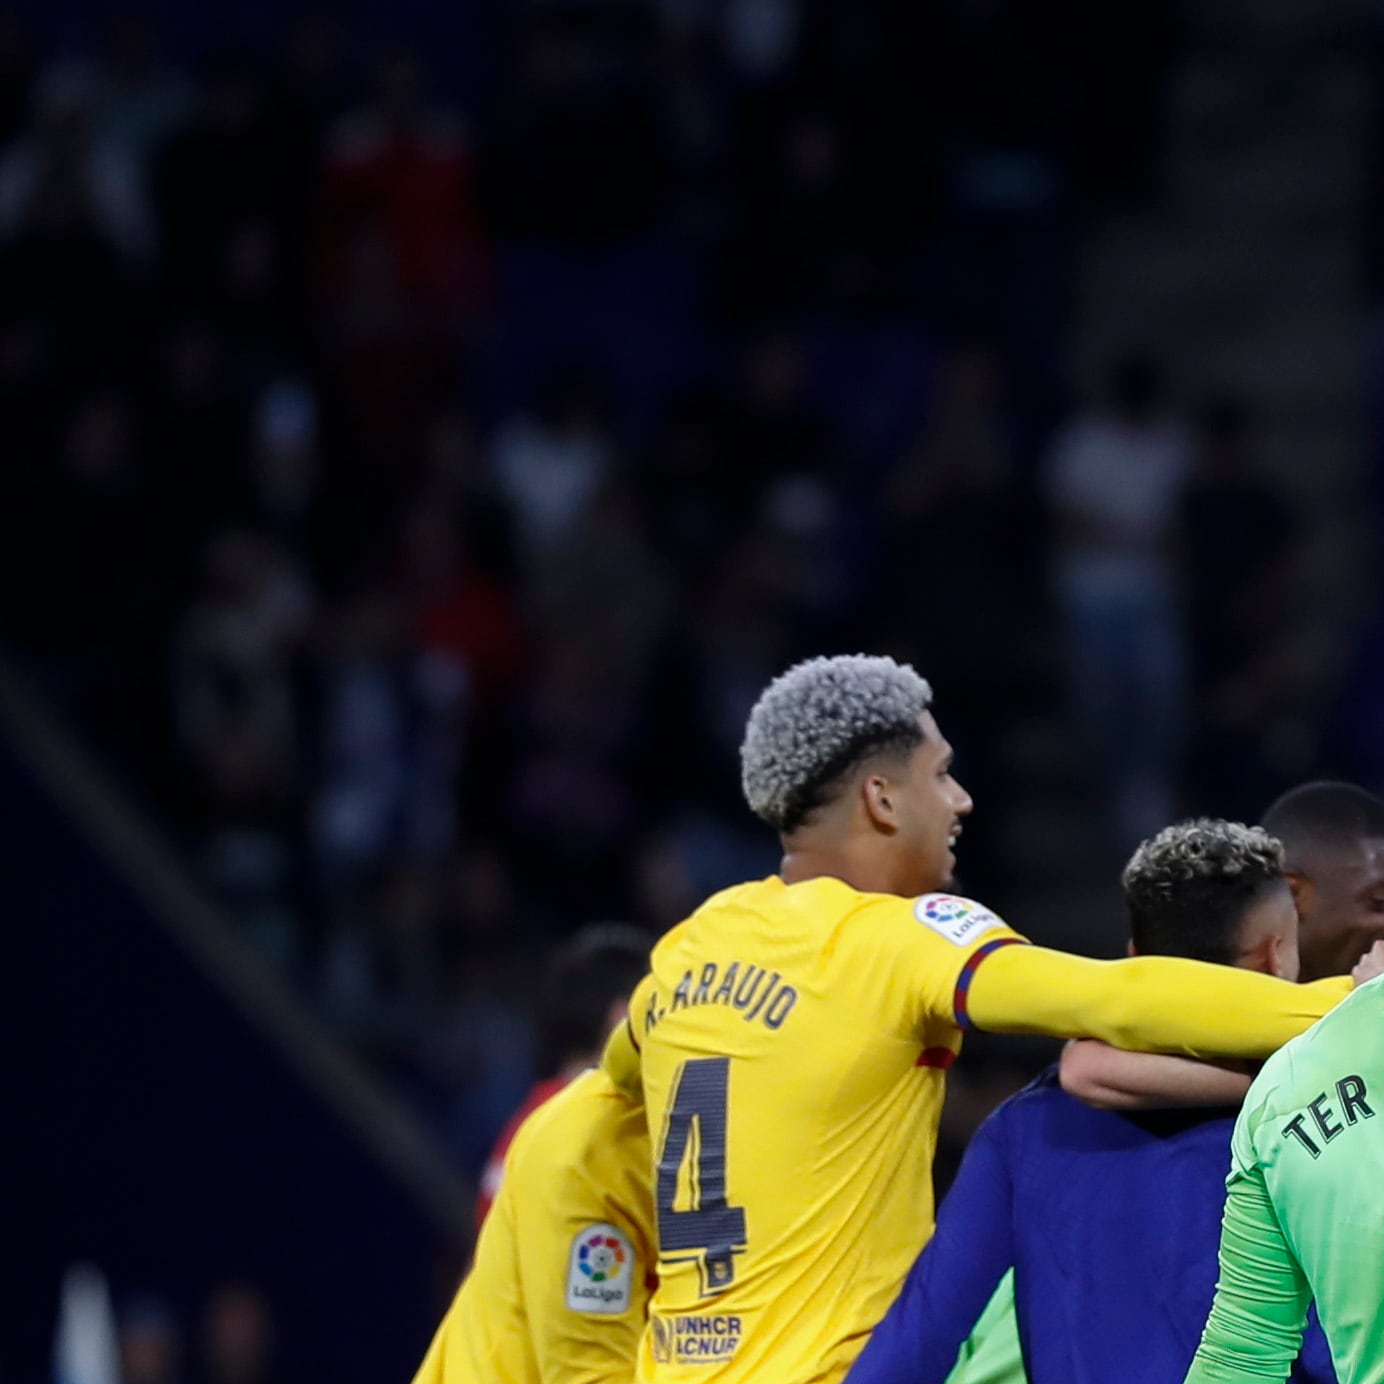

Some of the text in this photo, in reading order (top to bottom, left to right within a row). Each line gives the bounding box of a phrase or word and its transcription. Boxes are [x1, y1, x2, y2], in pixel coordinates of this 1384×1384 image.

[671, 962, 799, 1030] ARAUJO
[1281, 1074, 1376, 1160] TER
[656, 1057, 749, 1298] 4
[574, 1286, 623, 1303] LaLiga
[675, 1316, 742, 1335] UNHCR
